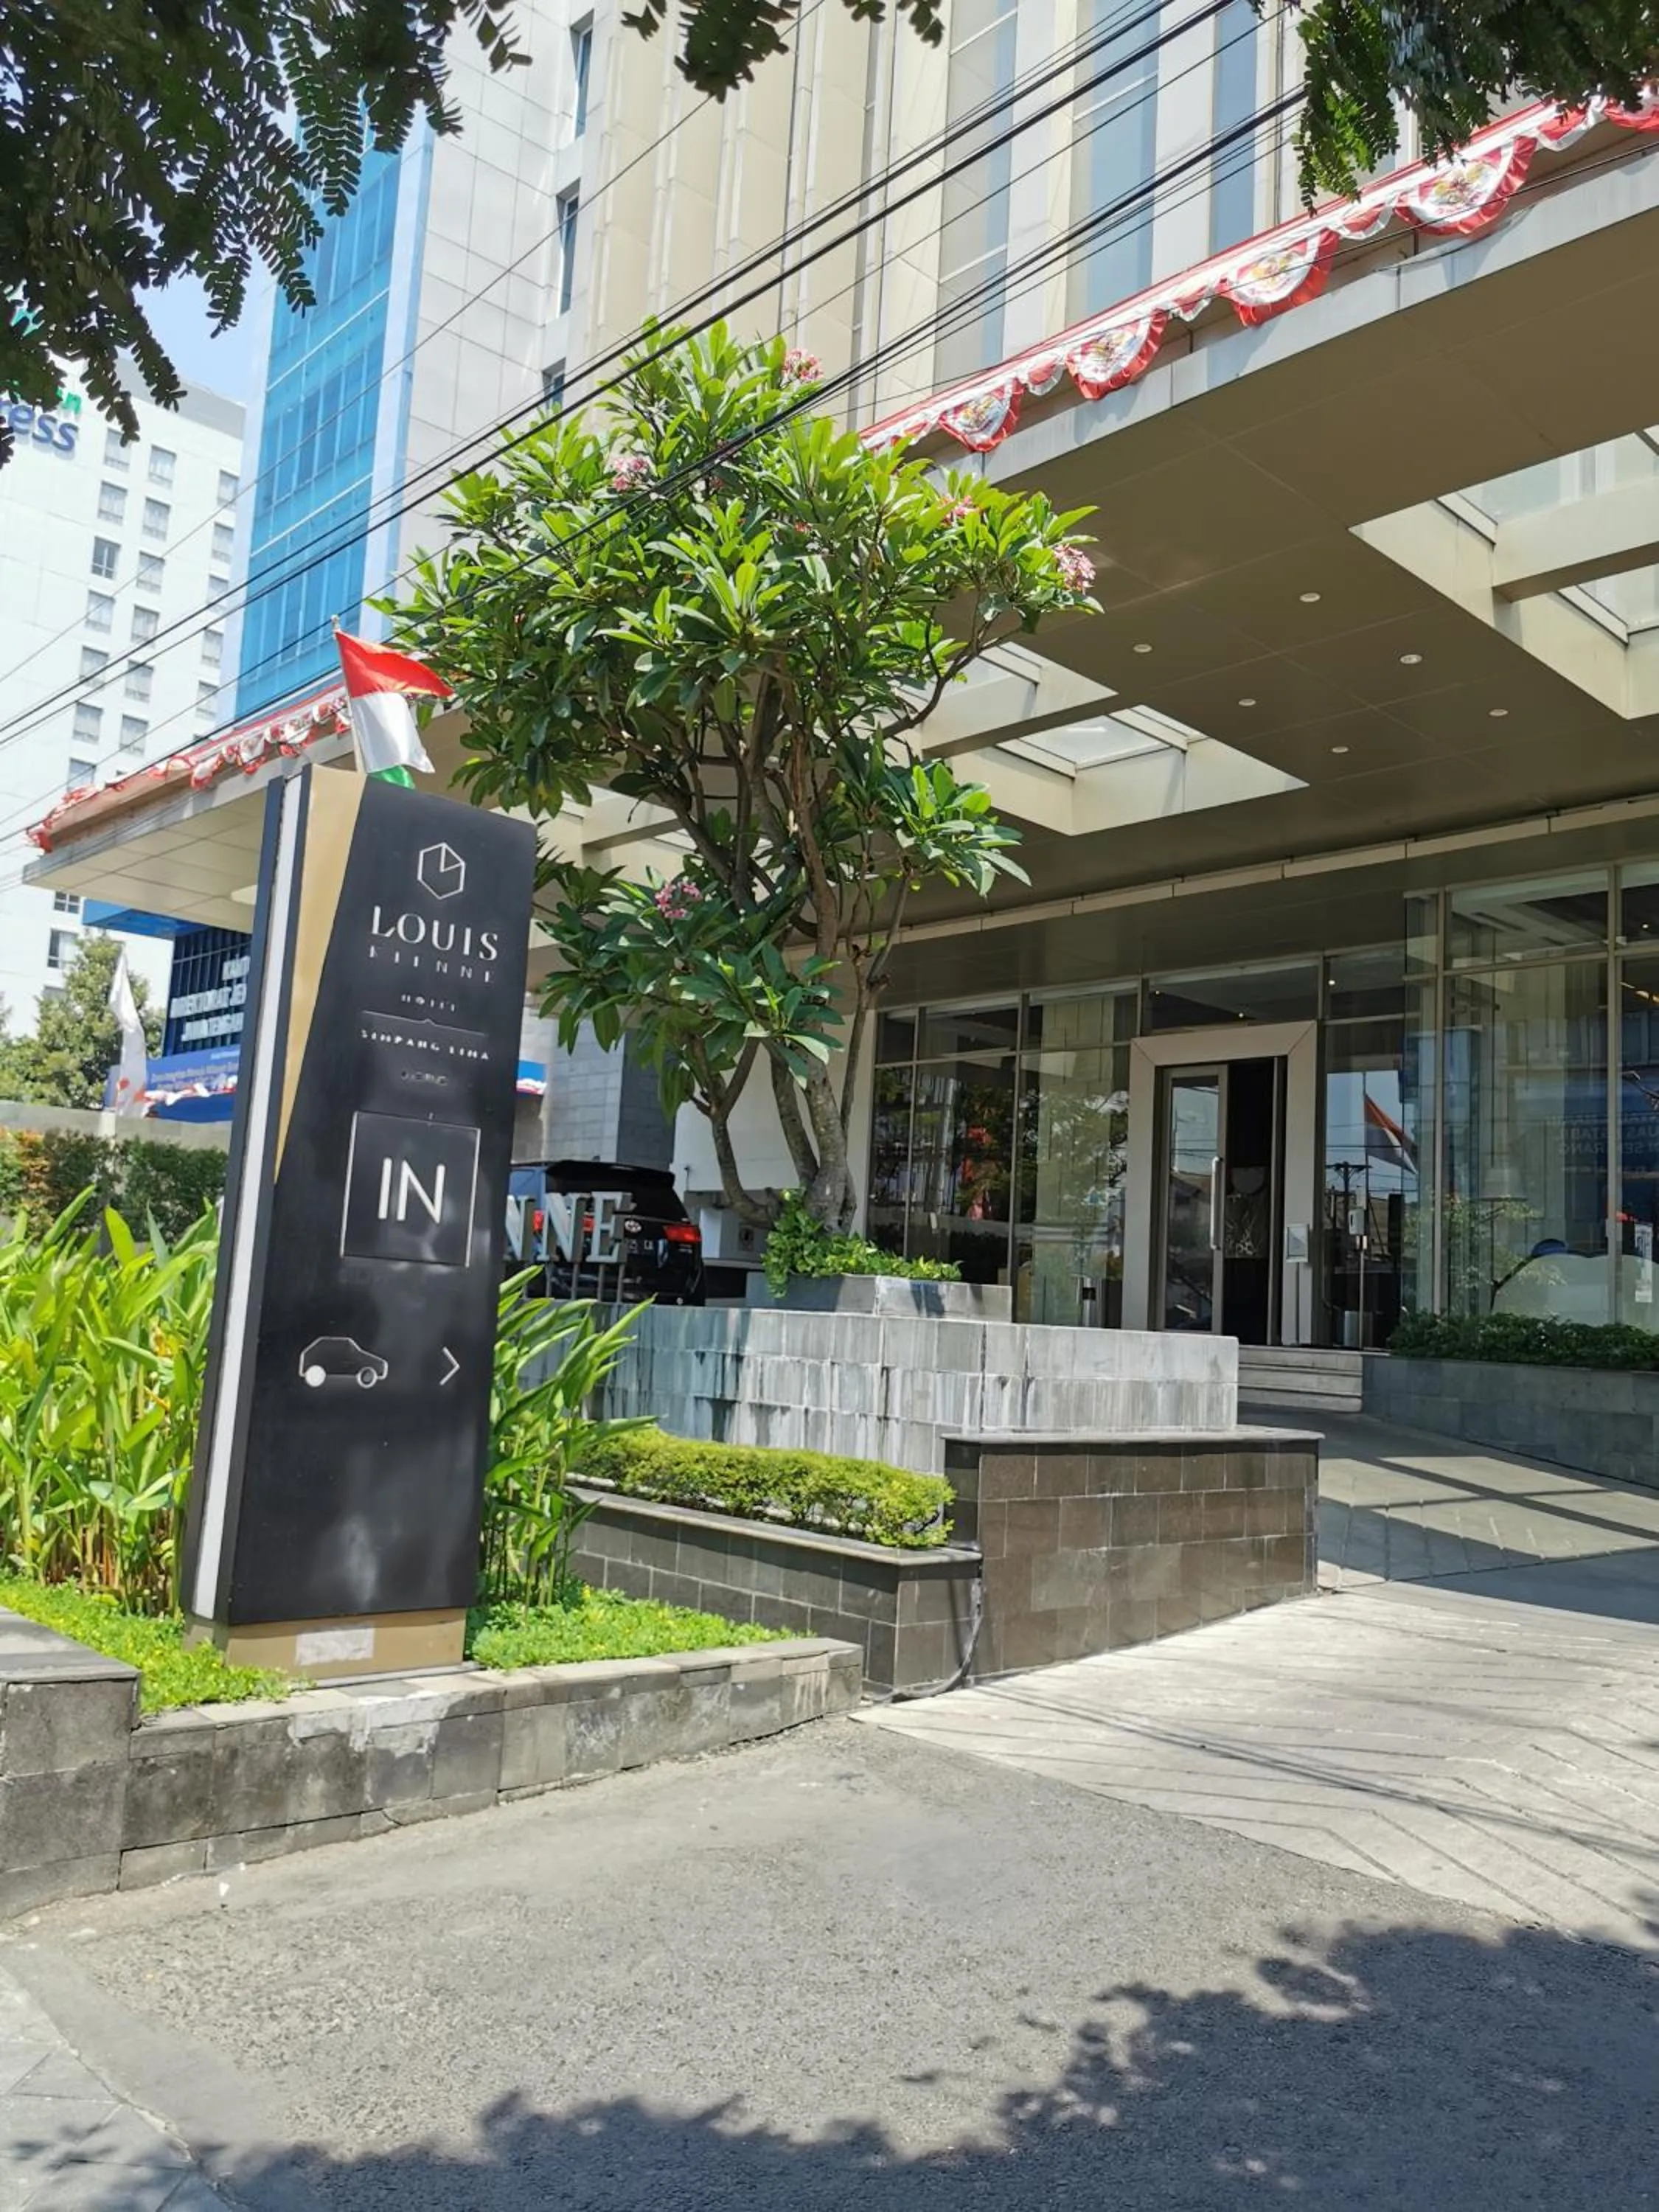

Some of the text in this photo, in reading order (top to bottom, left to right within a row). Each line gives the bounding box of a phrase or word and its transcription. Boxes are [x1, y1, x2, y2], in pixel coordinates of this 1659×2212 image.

[371, 905, 498, 961] LOUIS
[361, 1029, 489, 1060] SIMPANG LIMA
[378, 1157, 446, 1224] IN
